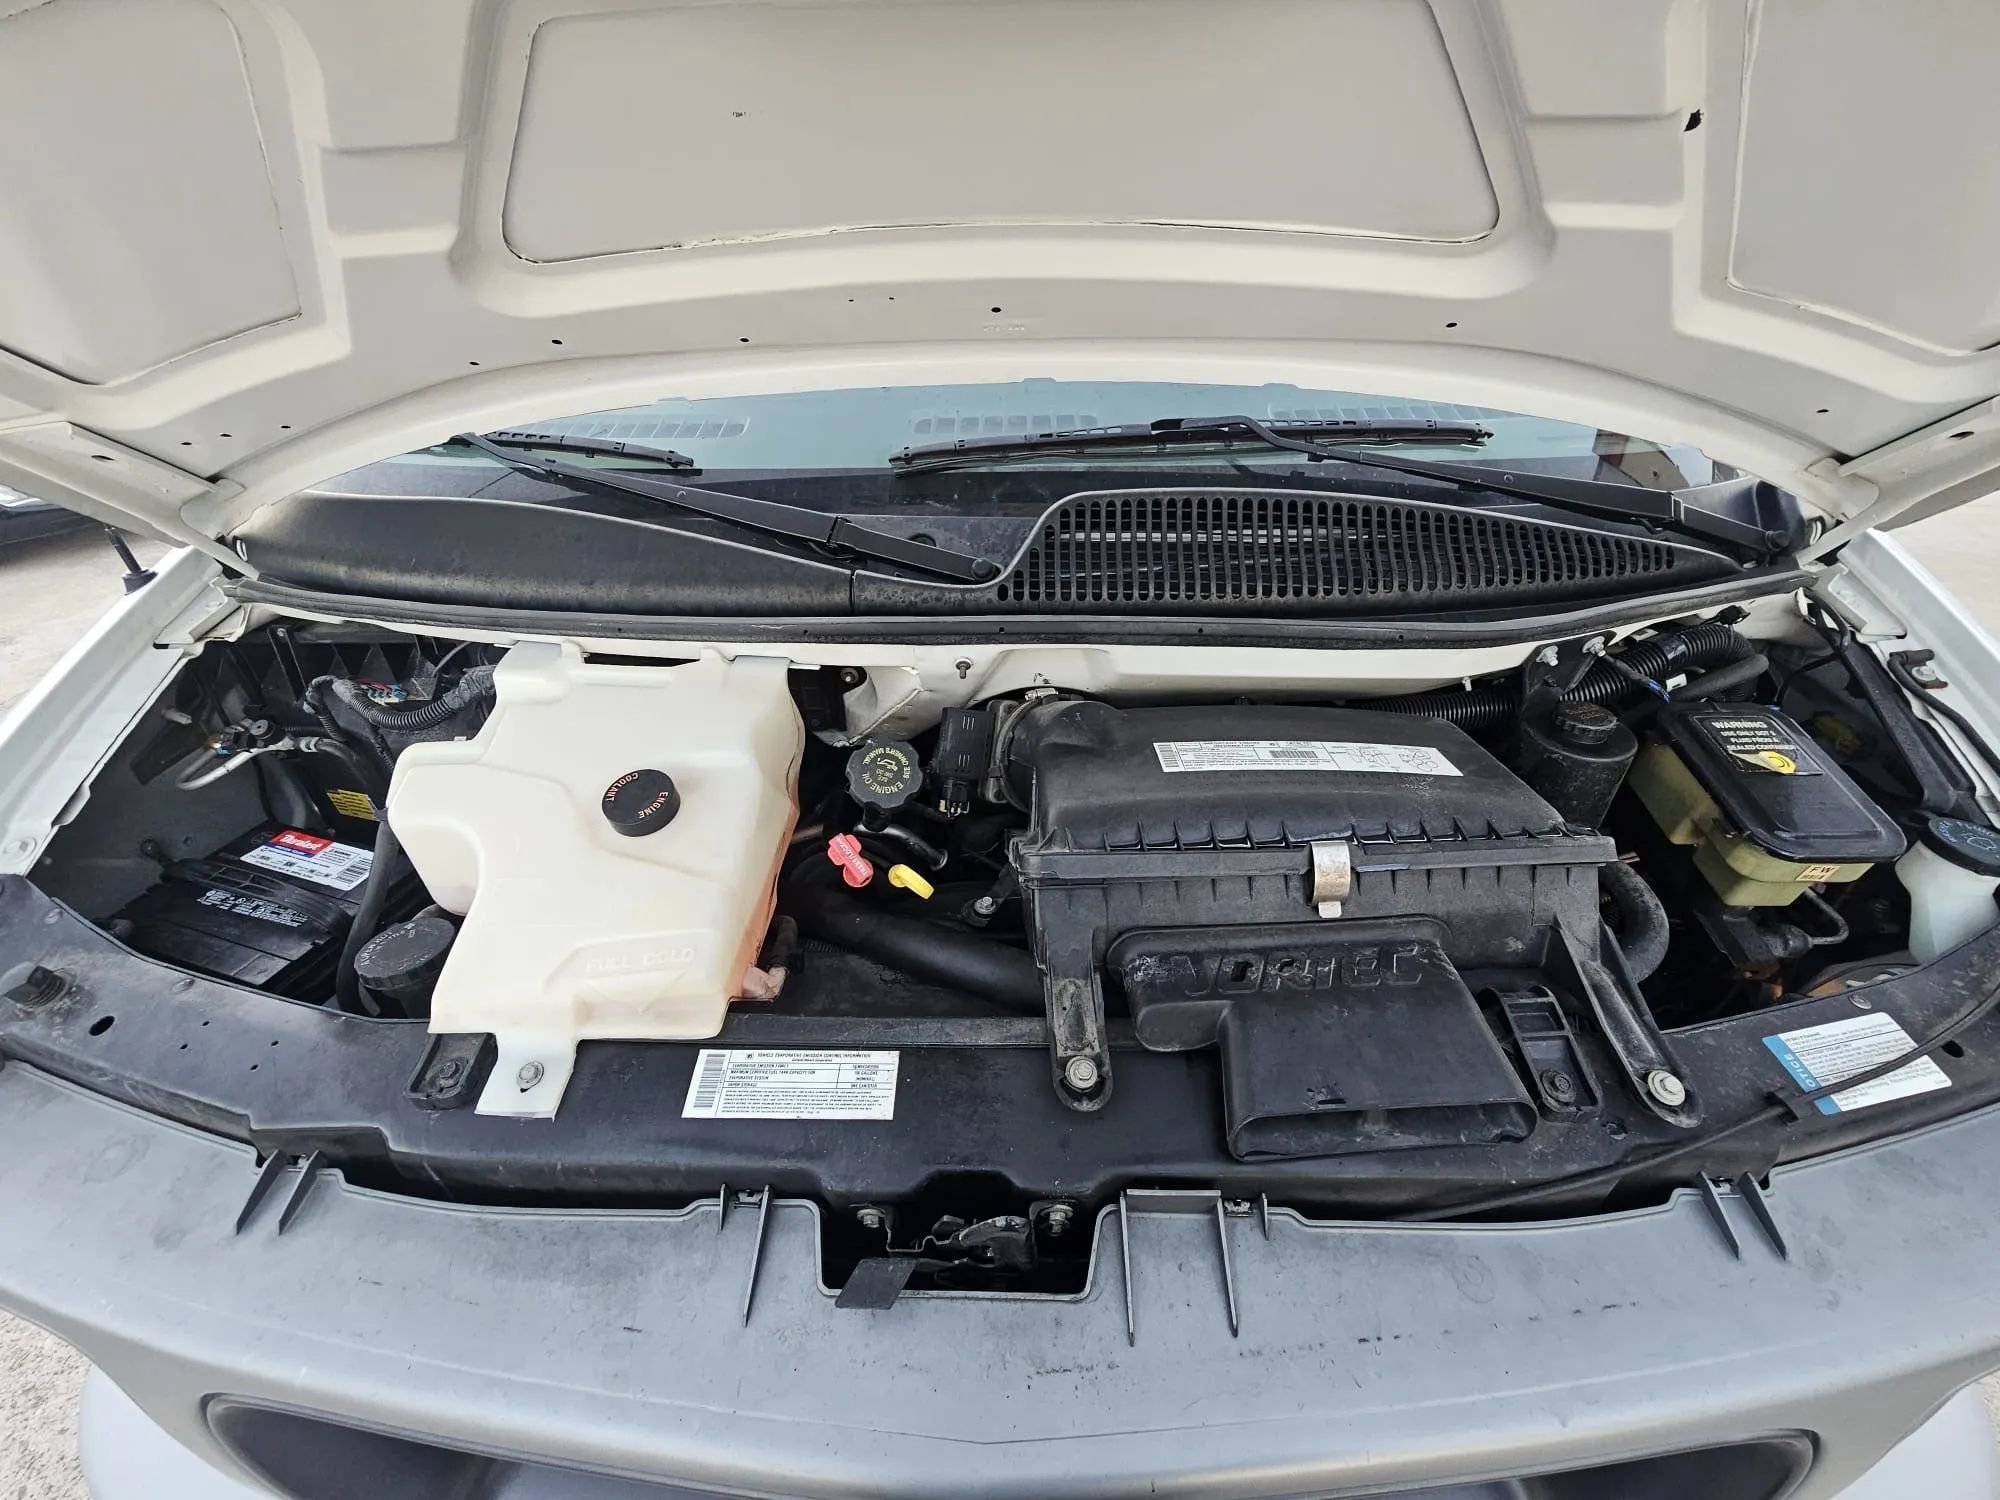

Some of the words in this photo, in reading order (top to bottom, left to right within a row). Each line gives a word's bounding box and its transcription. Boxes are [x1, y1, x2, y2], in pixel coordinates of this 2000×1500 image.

[1712, 721, 1768, 729] WARNING
[862, 747, 885, 765] MANUAL
[861, 770, 873, 784] OIL
[606, 772, 639, 802] COOLANT
[870, 781, 904, 794] ENGINE
[637, 791, 669, 819] ENGINE
[1784, 1053, 1816, 1088] OTICE
